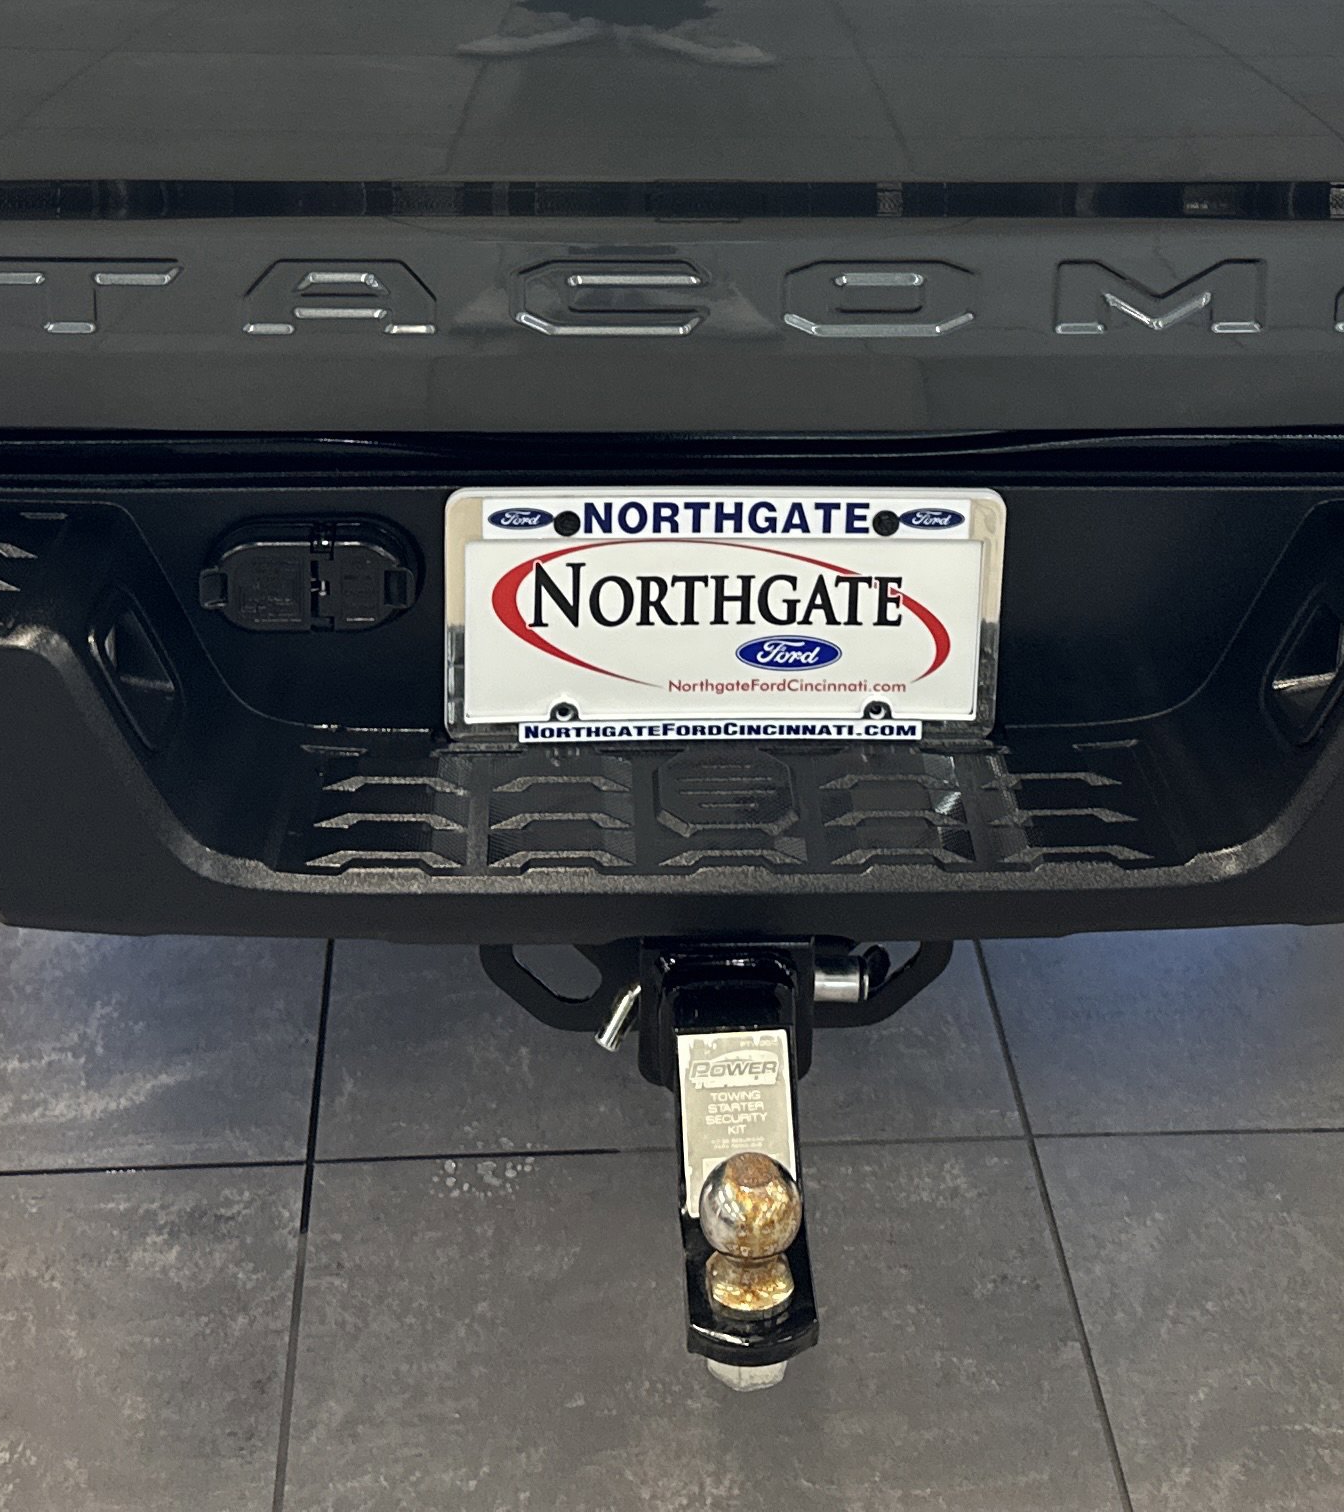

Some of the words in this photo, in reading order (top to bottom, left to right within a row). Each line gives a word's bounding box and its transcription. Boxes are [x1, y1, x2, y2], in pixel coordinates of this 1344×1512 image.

[500, 511, 541, 526] Ford
[583, 501, 871, 534] NORTHGATE
[911, 511, 951, 526] Ford
[756, 640, 821, 664] Ford
[668, 678, 907, 694] NorthgateFordCincinnati.com
[690, 1060, 778, 1078] POWER
[710, 1090, 761, 1103] TOWING
[707, 1101, 765, 1114] STARTER
[705, 1112, 768, 1125] SECURITY
[727, 1124, 747, 1136] KIT
